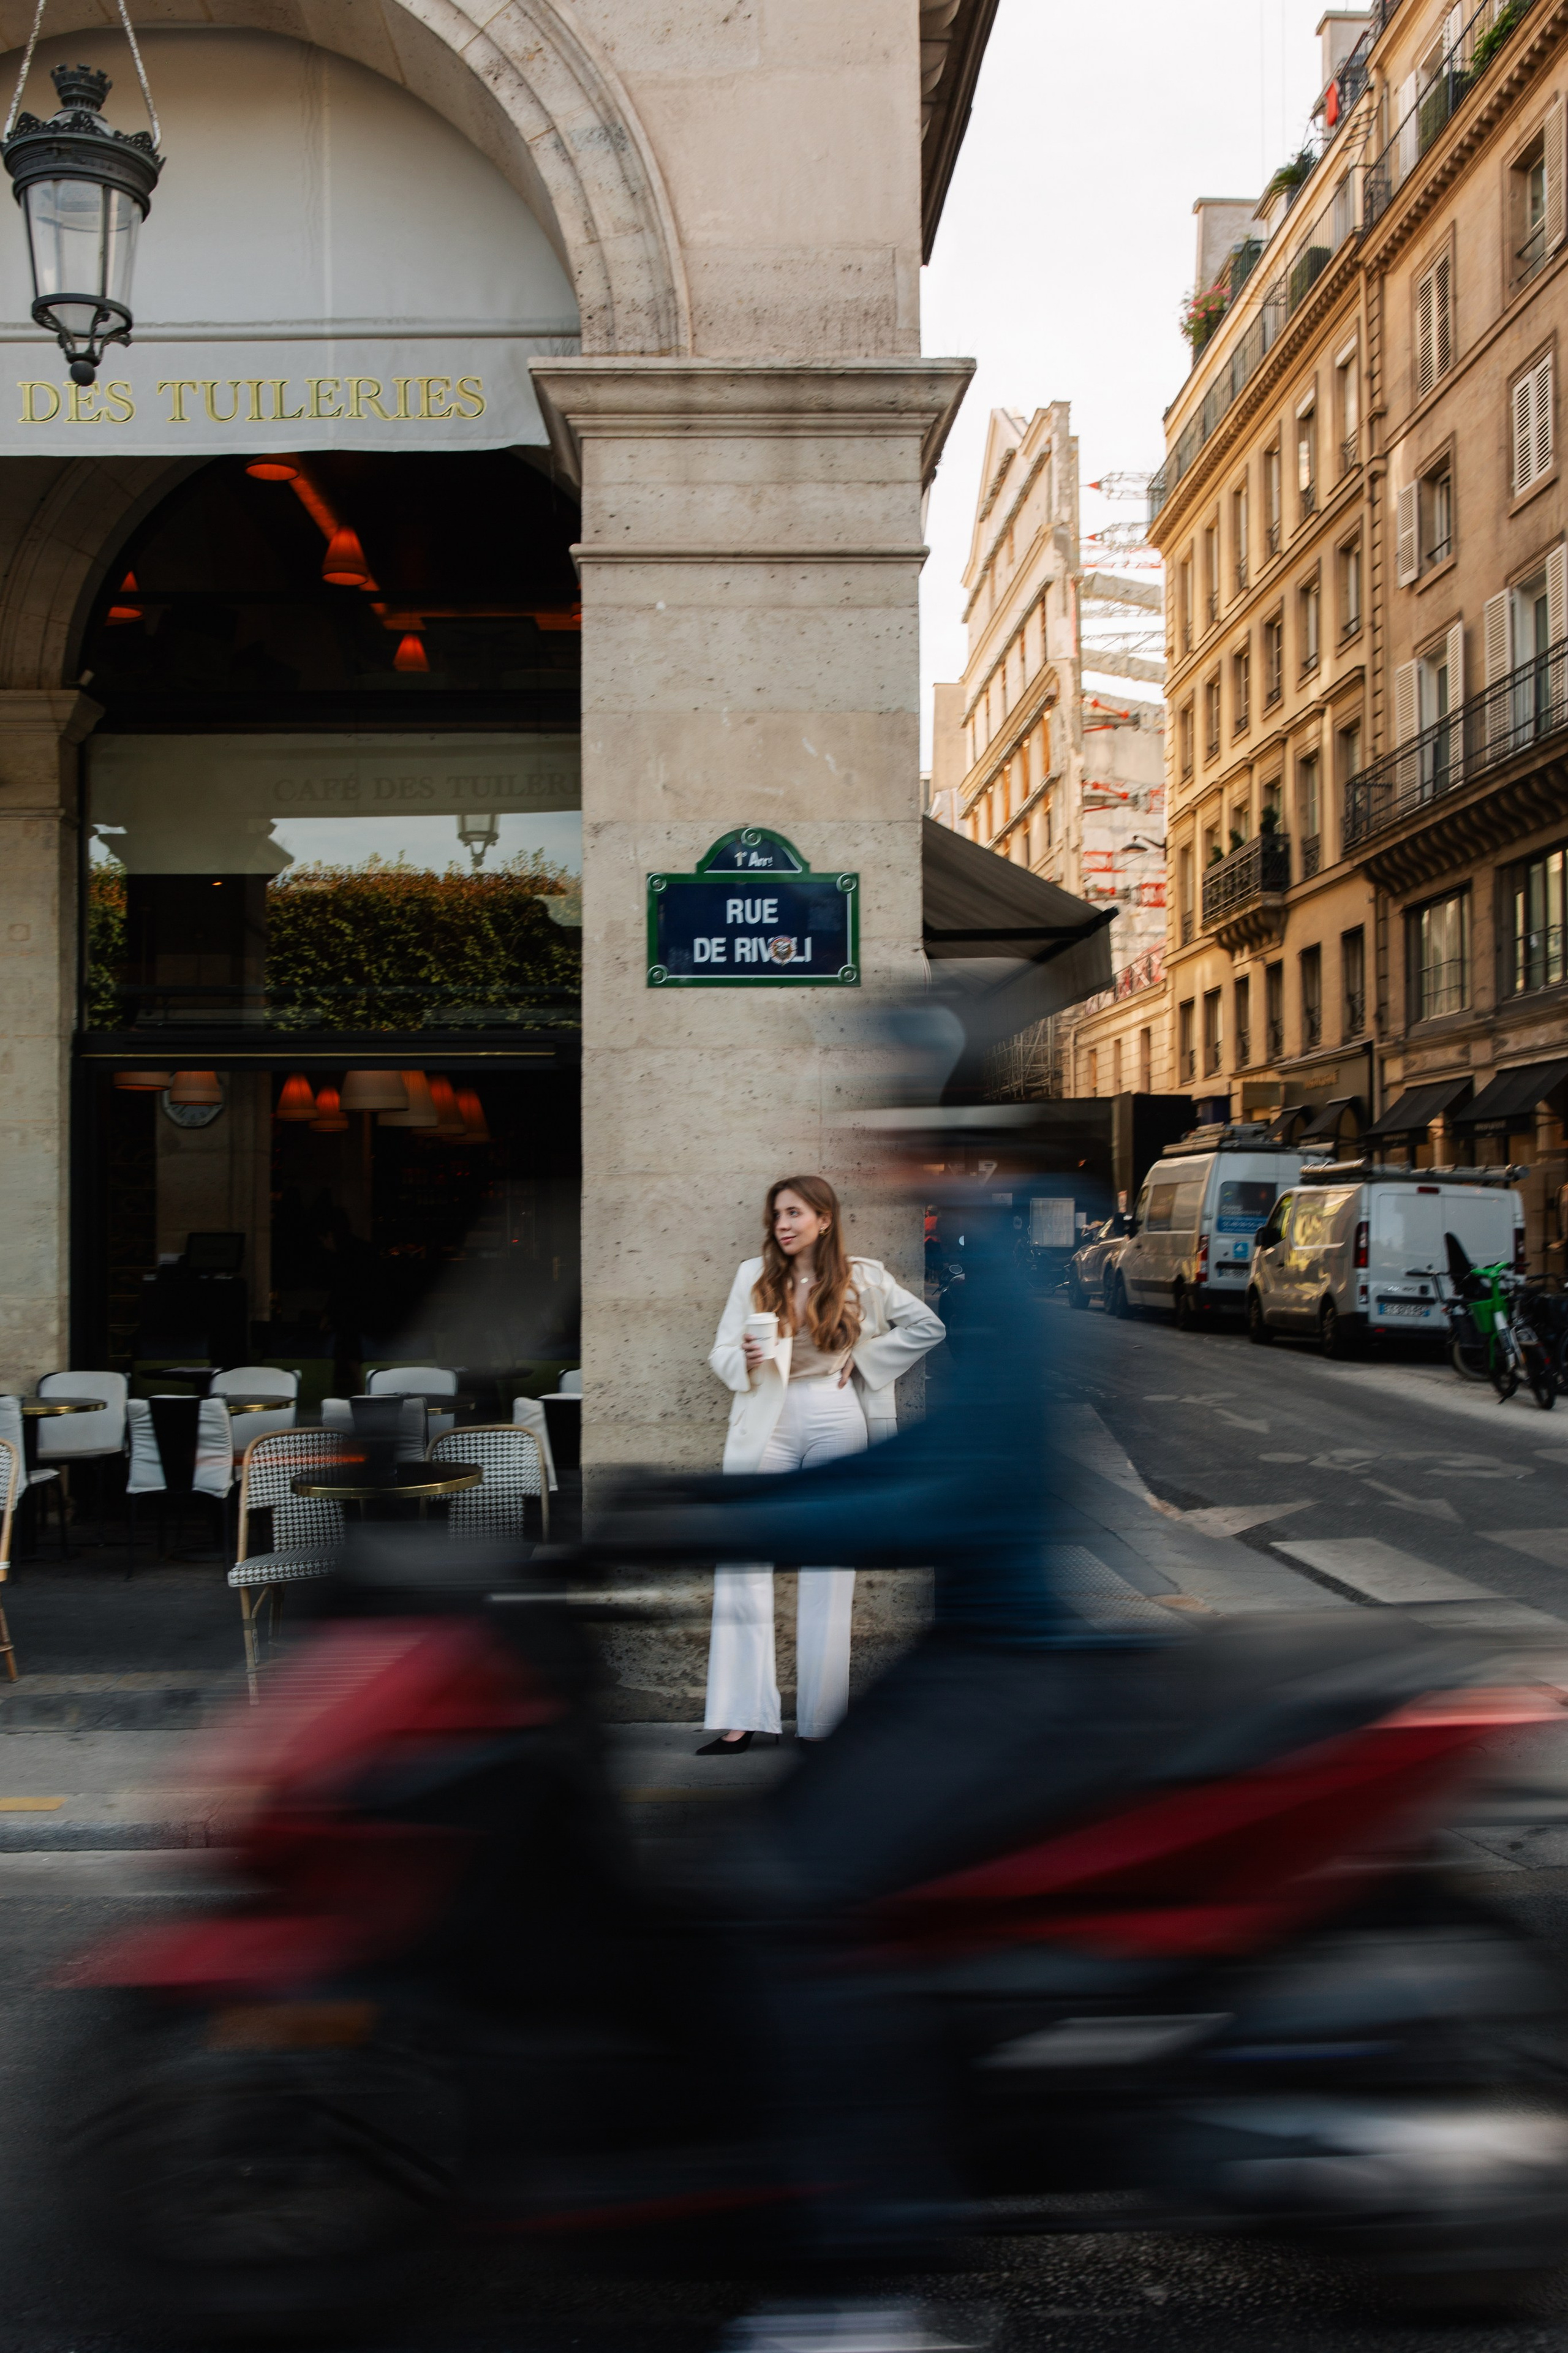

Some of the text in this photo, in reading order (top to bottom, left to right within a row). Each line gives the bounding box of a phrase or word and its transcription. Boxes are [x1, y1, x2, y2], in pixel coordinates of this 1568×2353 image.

[17, 376, 486, 423] DES TUILERIES
[273, 772, 361, 801] CAFÉ
[372, 776, 435, 799] DES
[726, 898, 778, 924] RUE
[693, 937, 726, 962] DE
